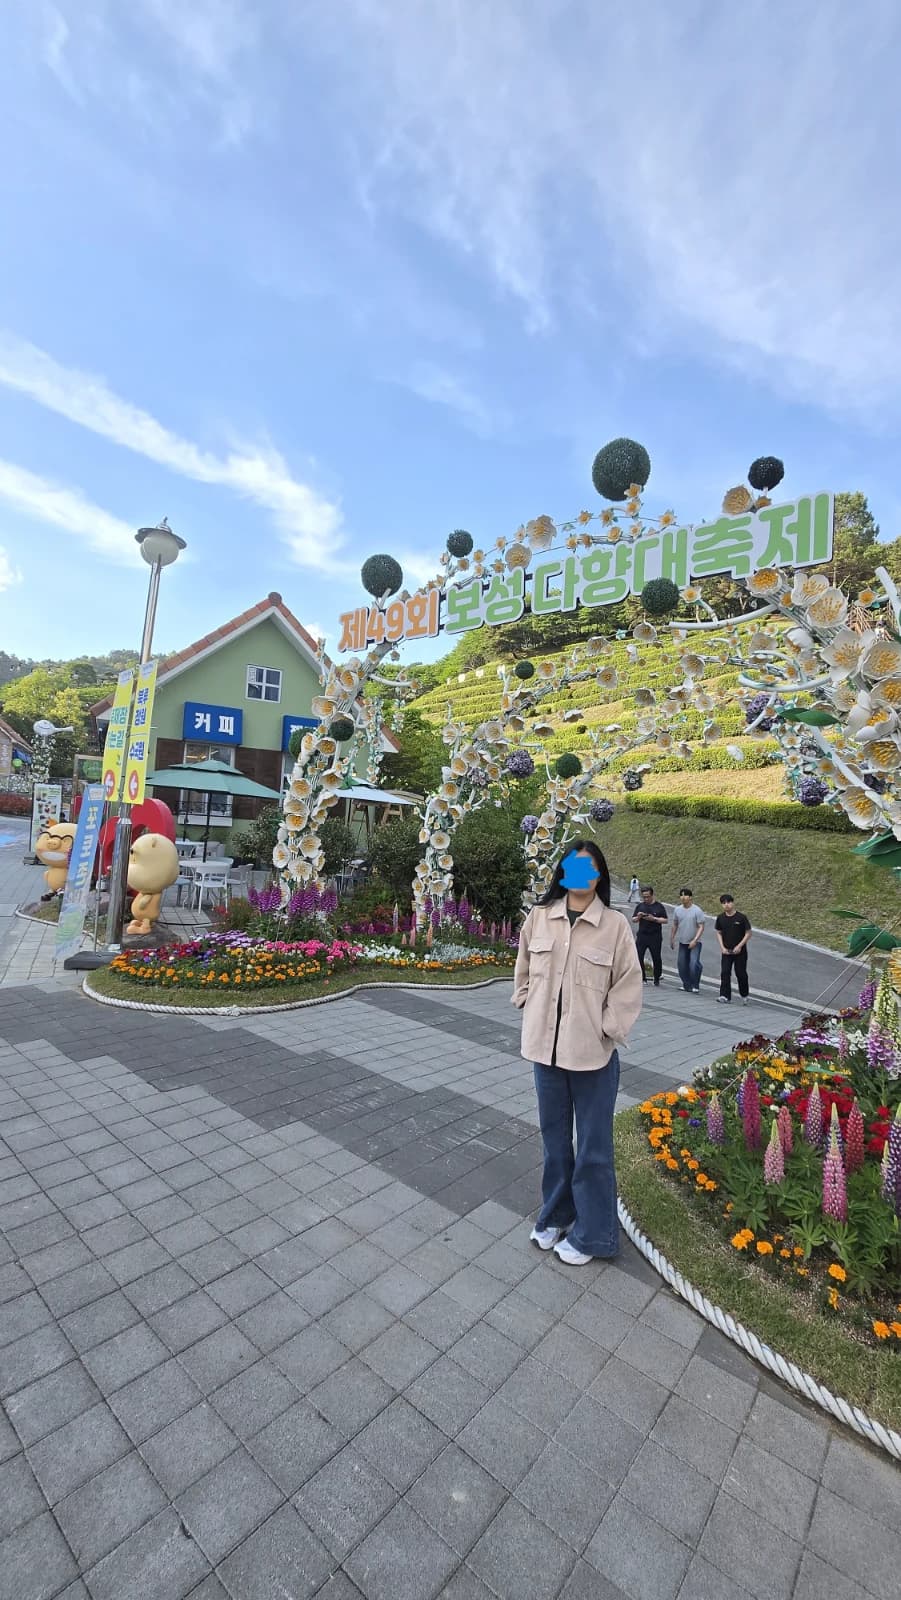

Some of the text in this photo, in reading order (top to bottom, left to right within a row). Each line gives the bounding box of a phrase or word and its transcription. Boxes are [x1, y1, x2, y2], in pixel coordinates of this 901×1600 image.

[338, 590, 437, 652] 제49회
[445, 568, 522, 632] 보성
[194, 712, 234, 736] 커피
